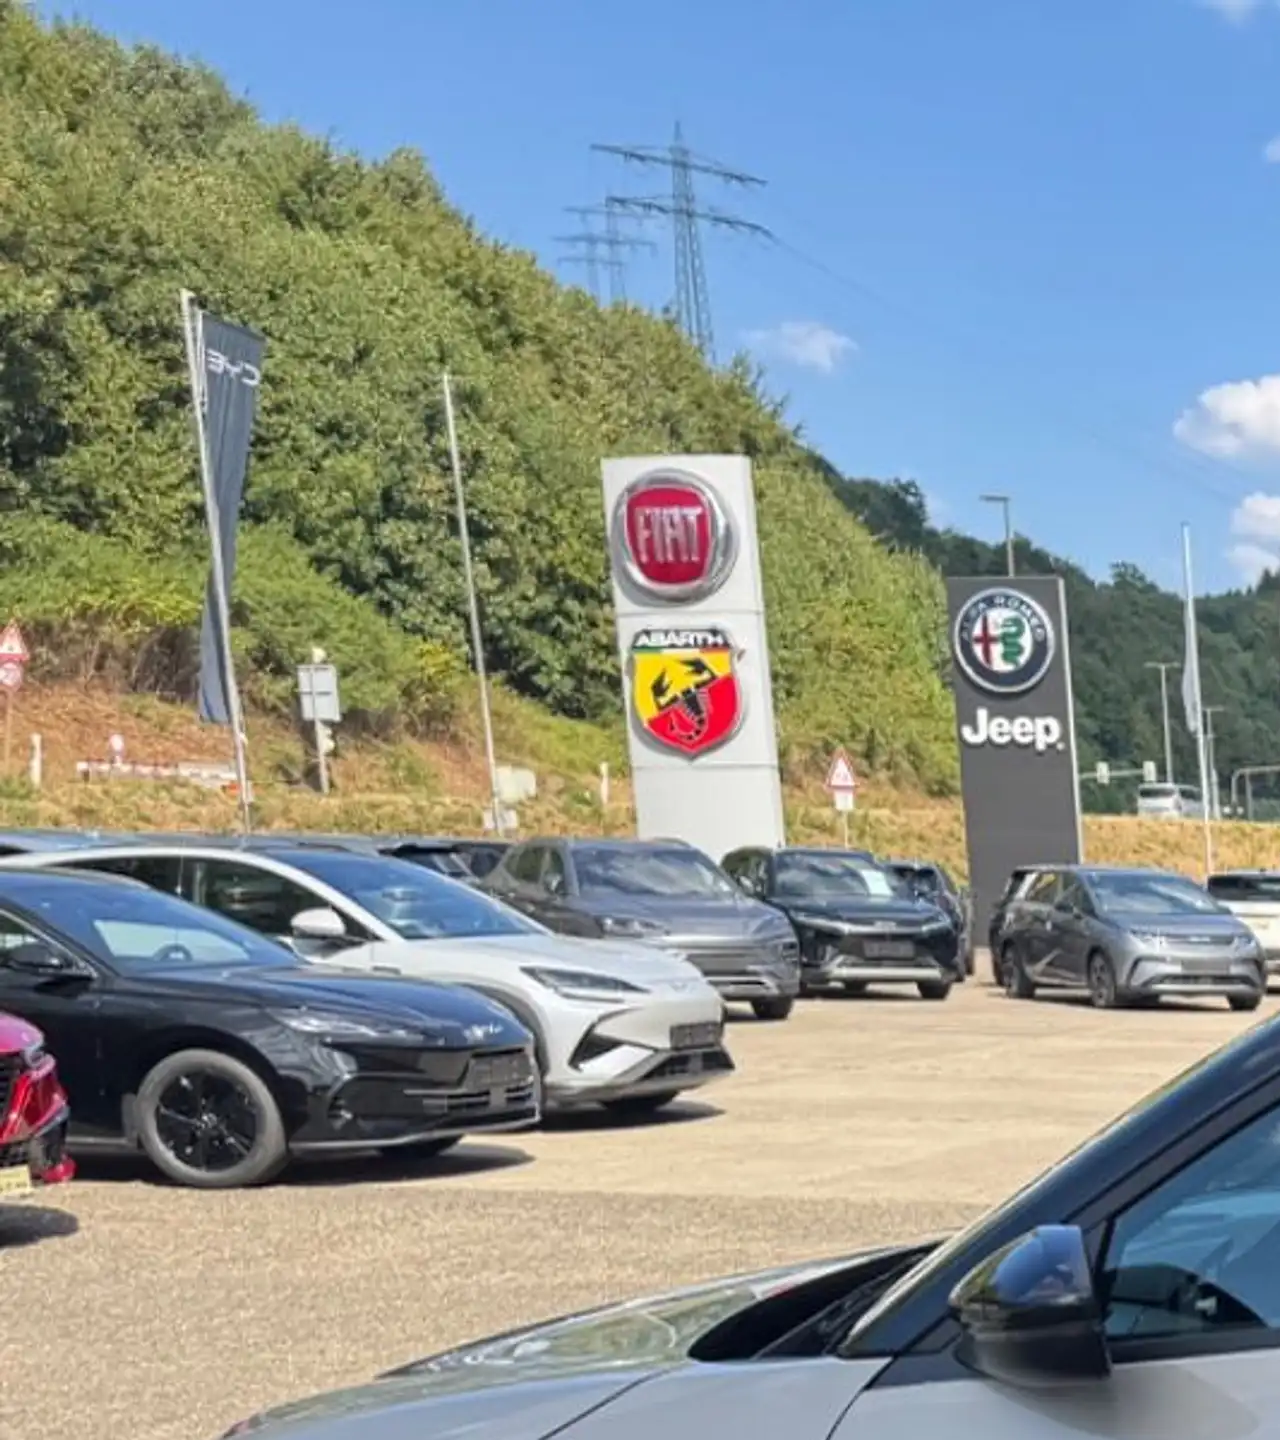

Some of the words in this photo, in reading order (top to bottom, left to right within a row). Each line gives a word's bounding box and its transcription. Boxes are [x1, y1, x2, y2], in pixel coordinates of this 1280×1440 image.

[634, 505, 704, 564] FIAT
[634, 629, 725, 648] ABARTH
[993, 596, 1046, 642] ROMEO
[961, 706, 1062, 752] Jeep
